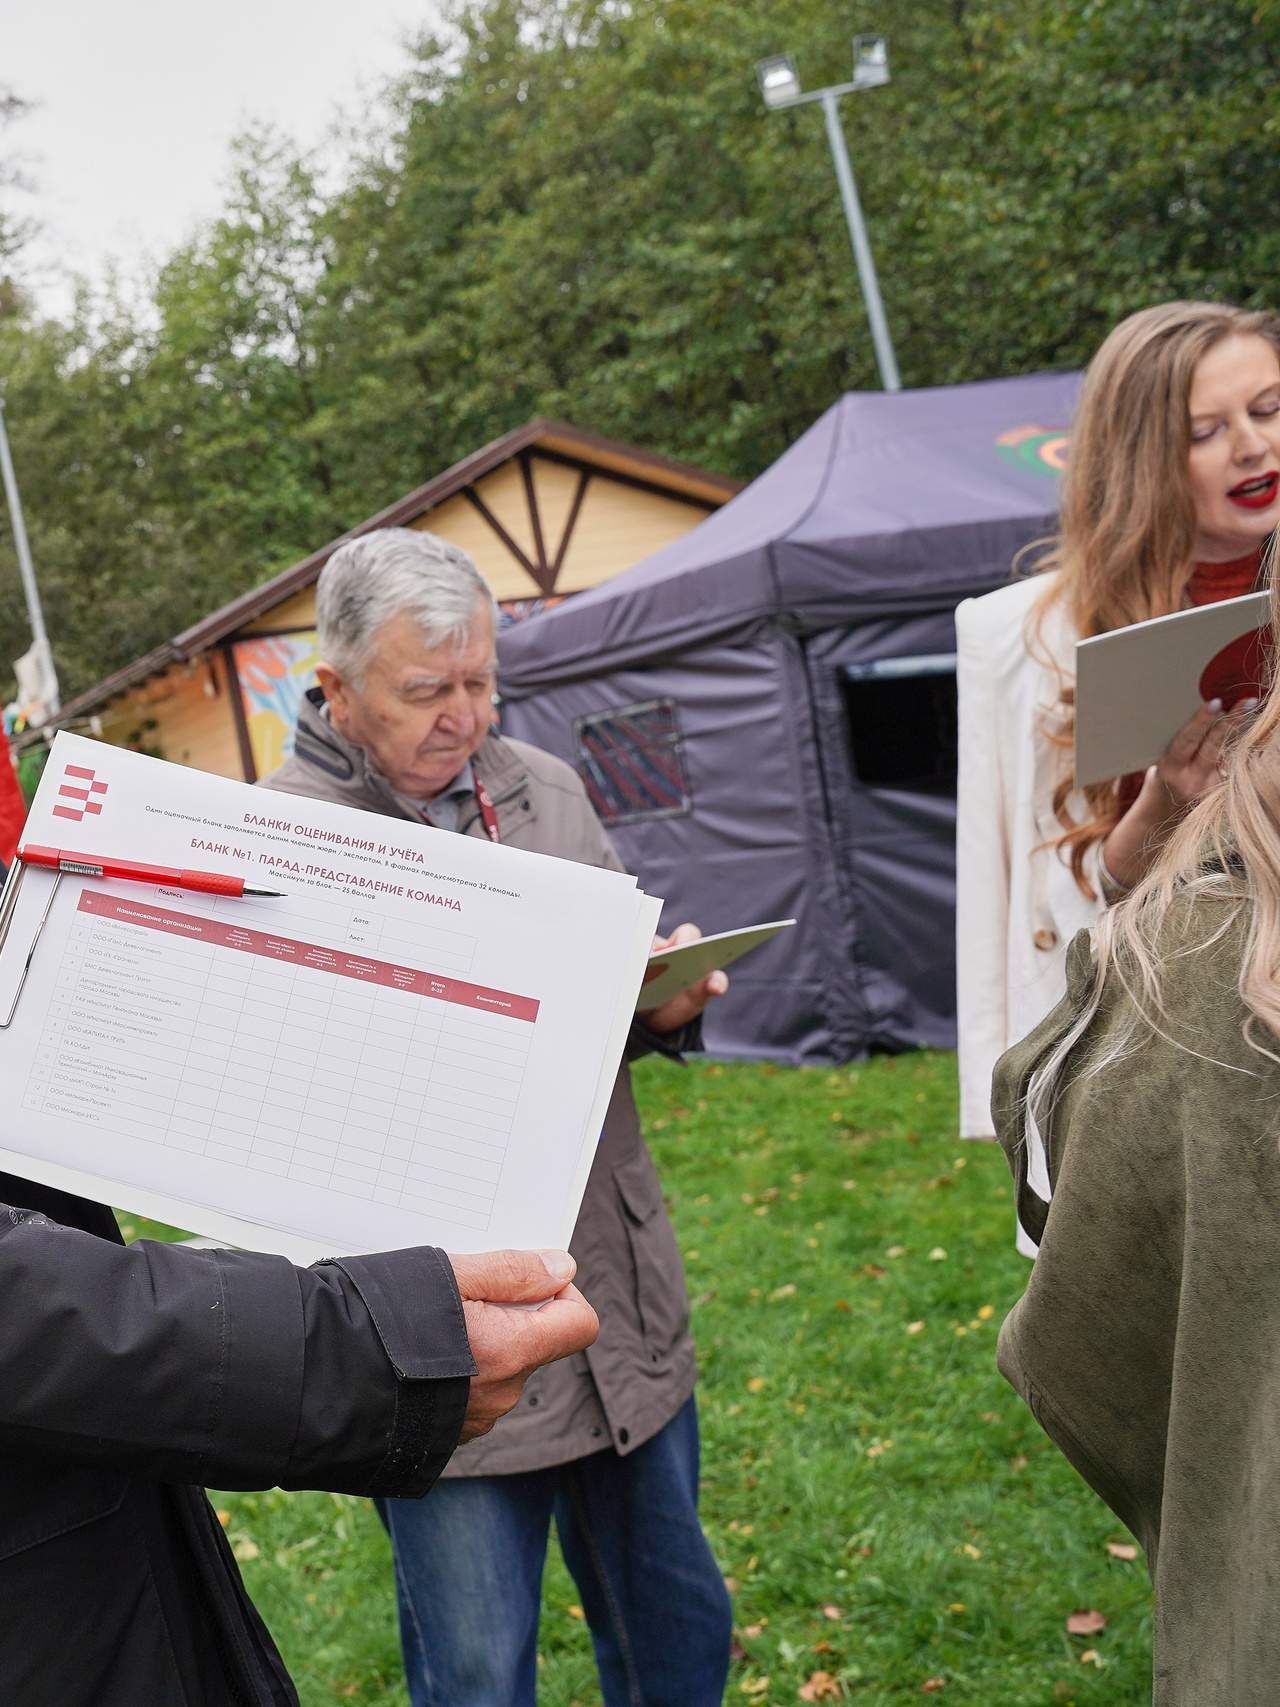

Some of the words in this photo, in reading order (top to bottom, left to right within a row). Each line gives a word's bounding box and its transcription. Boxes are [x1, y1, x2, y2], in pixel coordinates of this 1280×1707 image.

[243, 813, 291, 832] БЛАНКИ
[294, 825, 375, 852] ОЦЕНИВАНИЯ
[377, 844, 387, 855] И
[388, 847, 424, 864] УЧЁТА
[145, 805, 163, 814] Один
[163, 810, 202, 823] оценочный
[202, 818, 223, 827] бланк
[223, 824, 266, 837] заполняется
[266, 834, 289, 842] одним
[290, 839, 316, 849] членом
[317, 846, 337, 854] жюри
[343, 851, 382, 865] экспертом.
[390, 862, 420, 874] формах
[421, 870, 478, 888] предусмотрено
[488, 886, 522, 898] команды.
[190, 838, 230, 855] БЛАНК
[232, 847, 255, 862] №1.
[258, 854, 404, 896] ПАРАД-ПРЕДСТАВЛЕНИЕ
[406, 888, 462, 912] КОМАНД
[268, 869, 305, 883] Максимум
[315, 880, 333, 889] блок
[342, 886, 350, 894] 25
[351, 889, 376, 900] баллов
[158, 888, 185, 898] Подпись:
[96, 919, 112, 928] ООО
[116, 906, 162, 922] Наименование
[162, 919, 202, 932] организации
[352, 917, 369, 925] Дата:
[92, 933, 108, 942] ООО
[88, 948, 104, 956] ООО
[476, 995, 512, 1007] Комментарий
[71, 1010, 87, 1018] ООО
[67, 1024, 83, 1033] ООО
[59, 1053, 74, 1062] ООО
[53, 1072, 69, 1081] ООО
[49, 1087, 65, 1096] ООО
[45, 1102, 61, 1111] ООО
